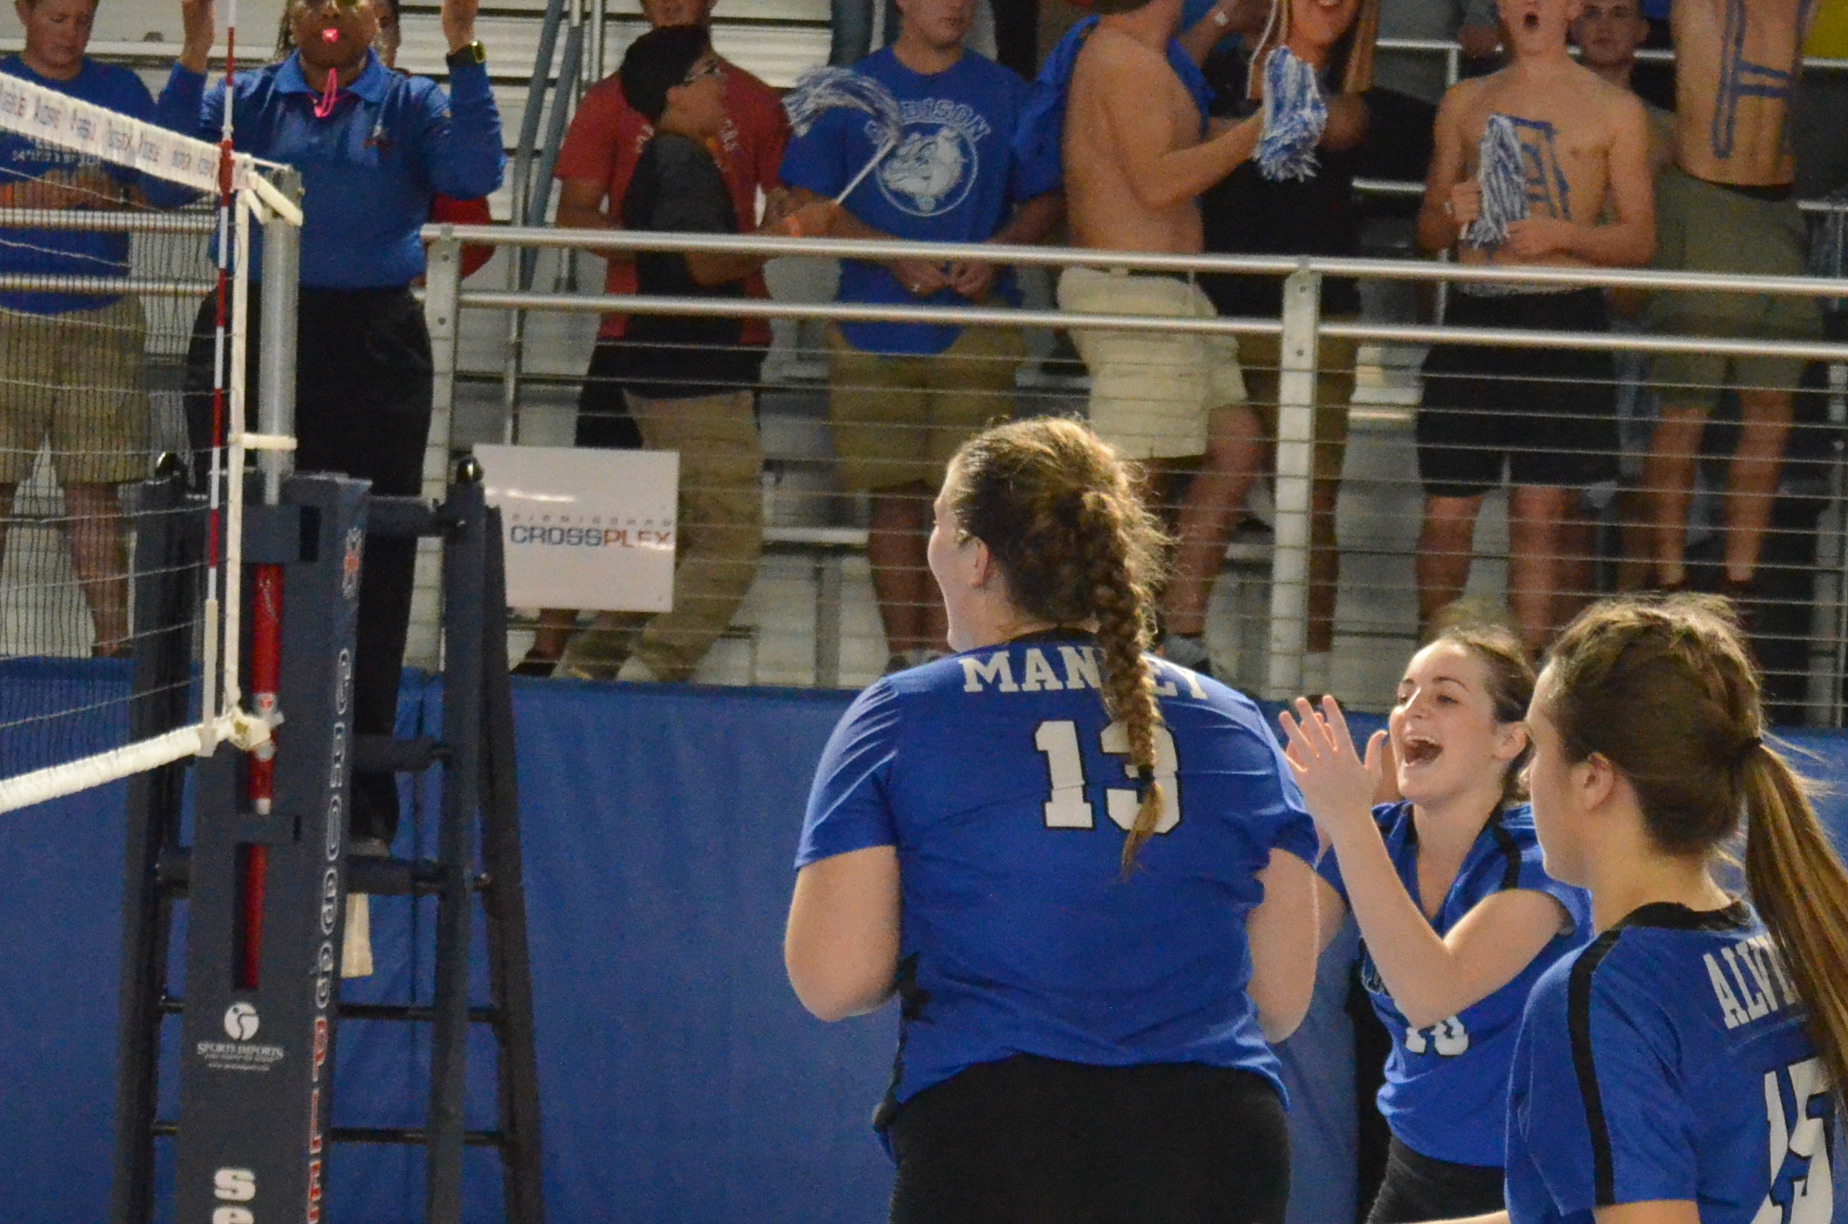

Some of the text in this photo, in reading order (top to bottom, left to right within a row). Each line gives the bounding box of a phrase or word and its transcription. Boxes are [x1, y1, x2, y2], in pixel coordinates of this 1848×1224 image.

[510, 526, 672, 547] CROSSPLEX
[958, 645, 1209, 699] MANEY
[1034, 719, 1180, 835] 13
